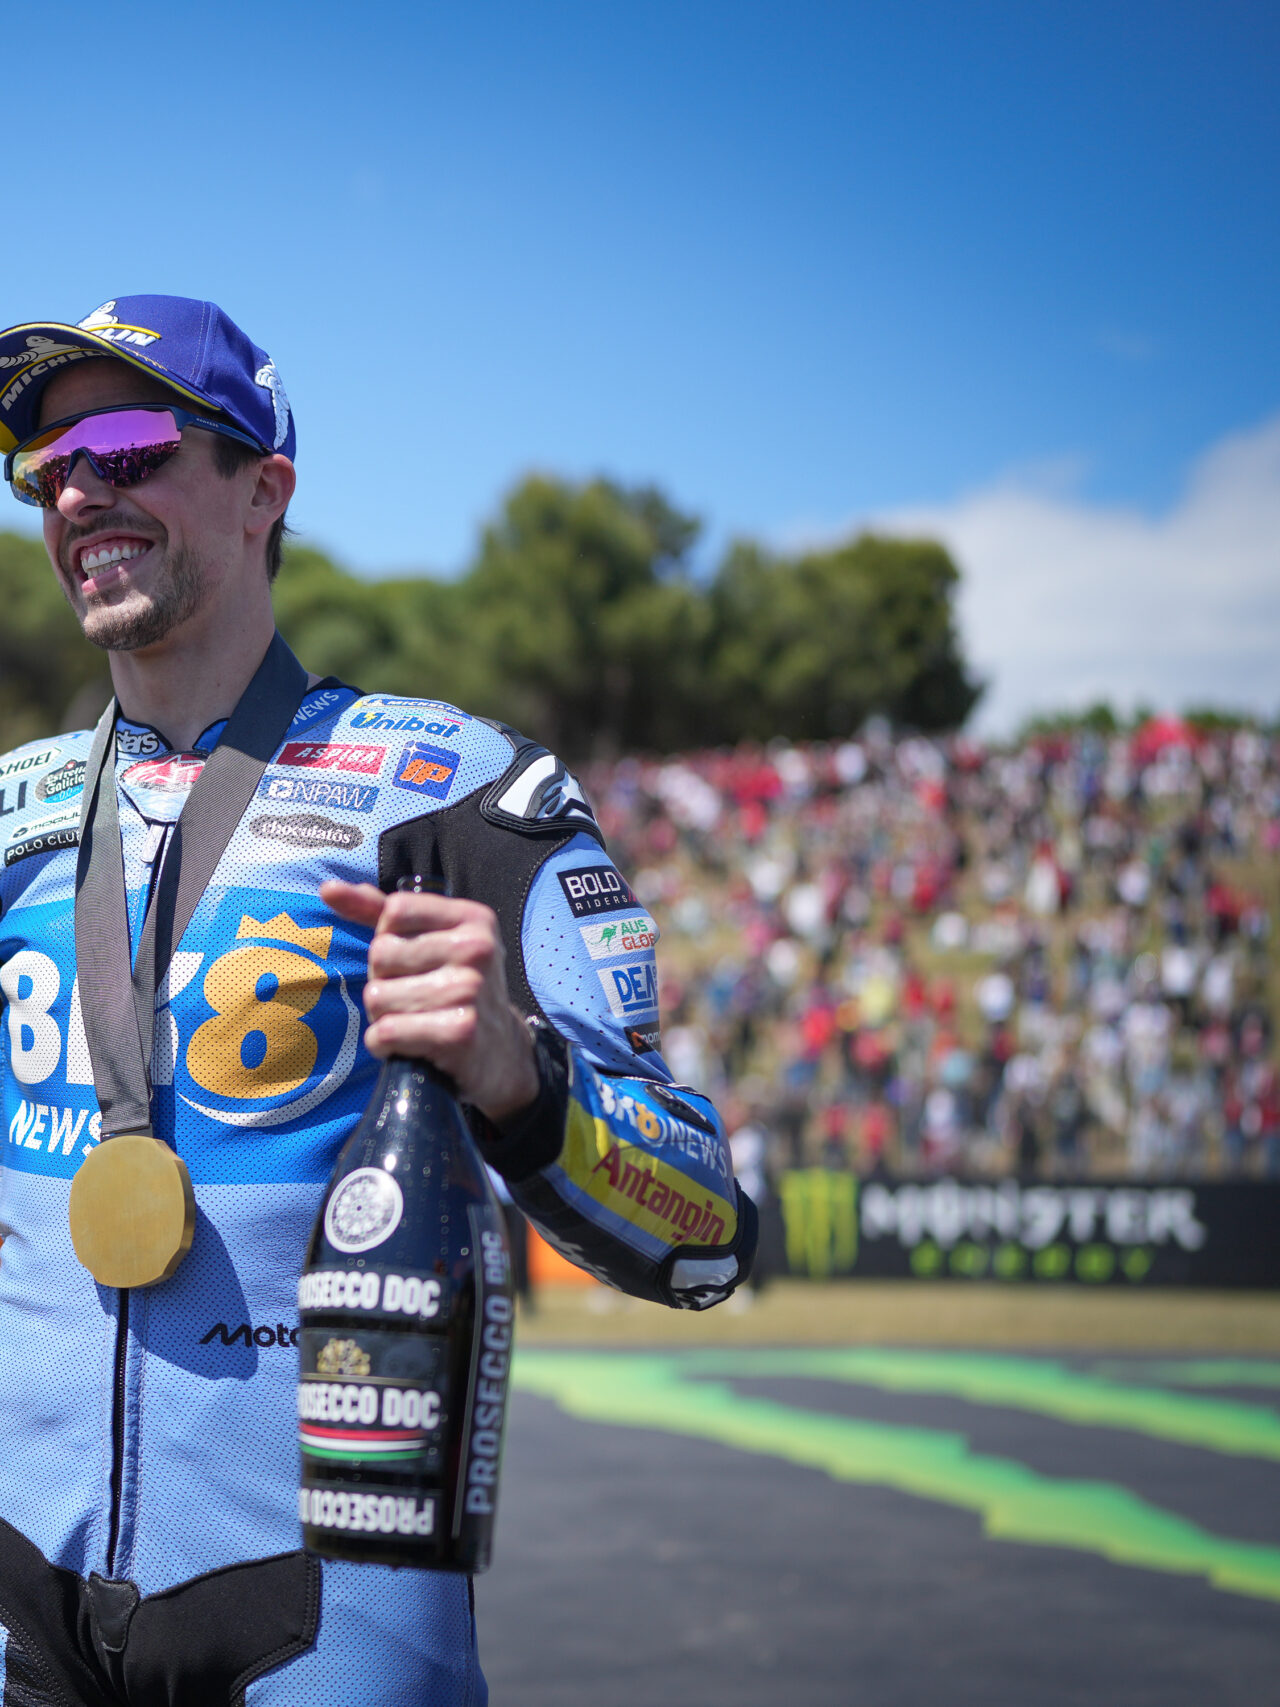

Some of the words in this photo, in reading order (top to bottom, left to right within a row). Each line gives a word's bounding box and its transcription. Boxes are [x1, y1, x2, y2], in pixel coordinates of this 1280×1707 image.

[292, 691, 341, 725] NEWS
[386, 699, 464, 715] MICHELIN
[349, 711, 463, 739] Unibat
[294, 745, 379, 766] ASPIRA
[399, 758, 453, 785] IP
[293, 780, 370, 808] NPAW
[7, 838, 44, 860] POLO
[565, 871, 621, 899] BOLD
[575, 894, 628, 911] RIDERS
[621, 919, 649, 936] AUS
[668, 1116, 728, 1178] NEWS
[591, 1144, 727, 1247] Antangin
[861, 1177, 1207, 1251] MONSTER
[382, 1273, 442, 1318] DOC
[381, 1387, 441, 1430] DOC
[465, 1294, 514, 1515] PROSECCO
[311, 1489, 435, 1537] PROSECCO
